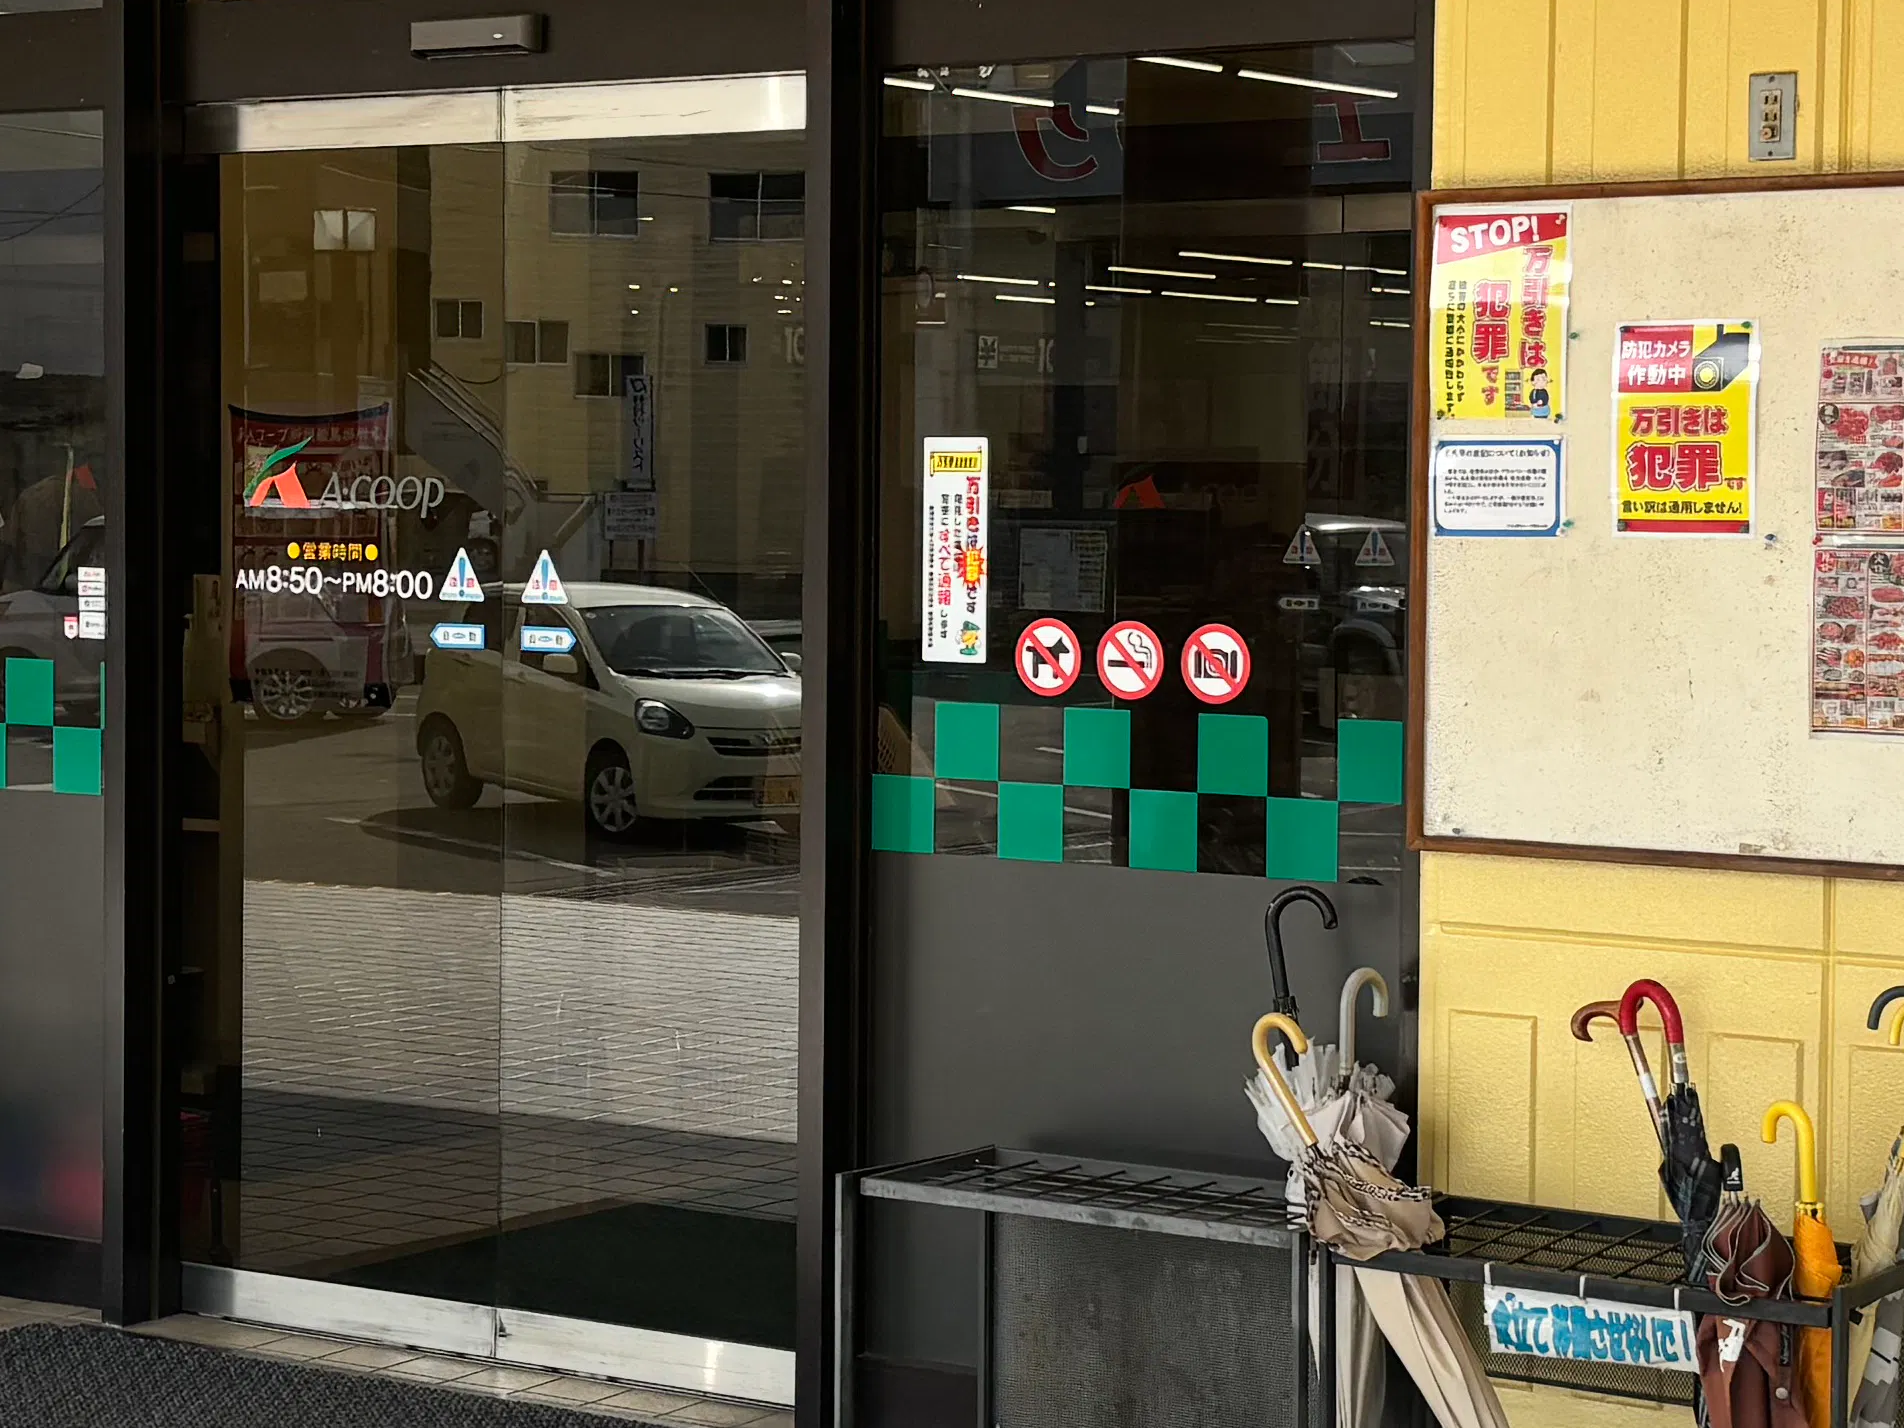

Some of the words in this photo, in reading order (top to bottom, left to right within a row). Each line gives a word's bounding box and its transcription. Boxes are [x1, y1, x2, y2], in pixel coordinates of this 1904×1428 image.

[1450, 214, 1540, 254] STOP!
[1520, 245, 1554, 369] 万引きは
[1472, 280, 1512, 406] 犯罪です
[1621, 340, 1690, 360] 防犯カメラ
[1627, 364, 1686, 386] 作動中
[1629, 405, 1730, 437] 万引きは
[1626, 440, 1746, 492] 犯罪です
[1622, 500, 1742, 515] 言い訳は通用しません!
[302, 542, 363, 563] 営業時間
